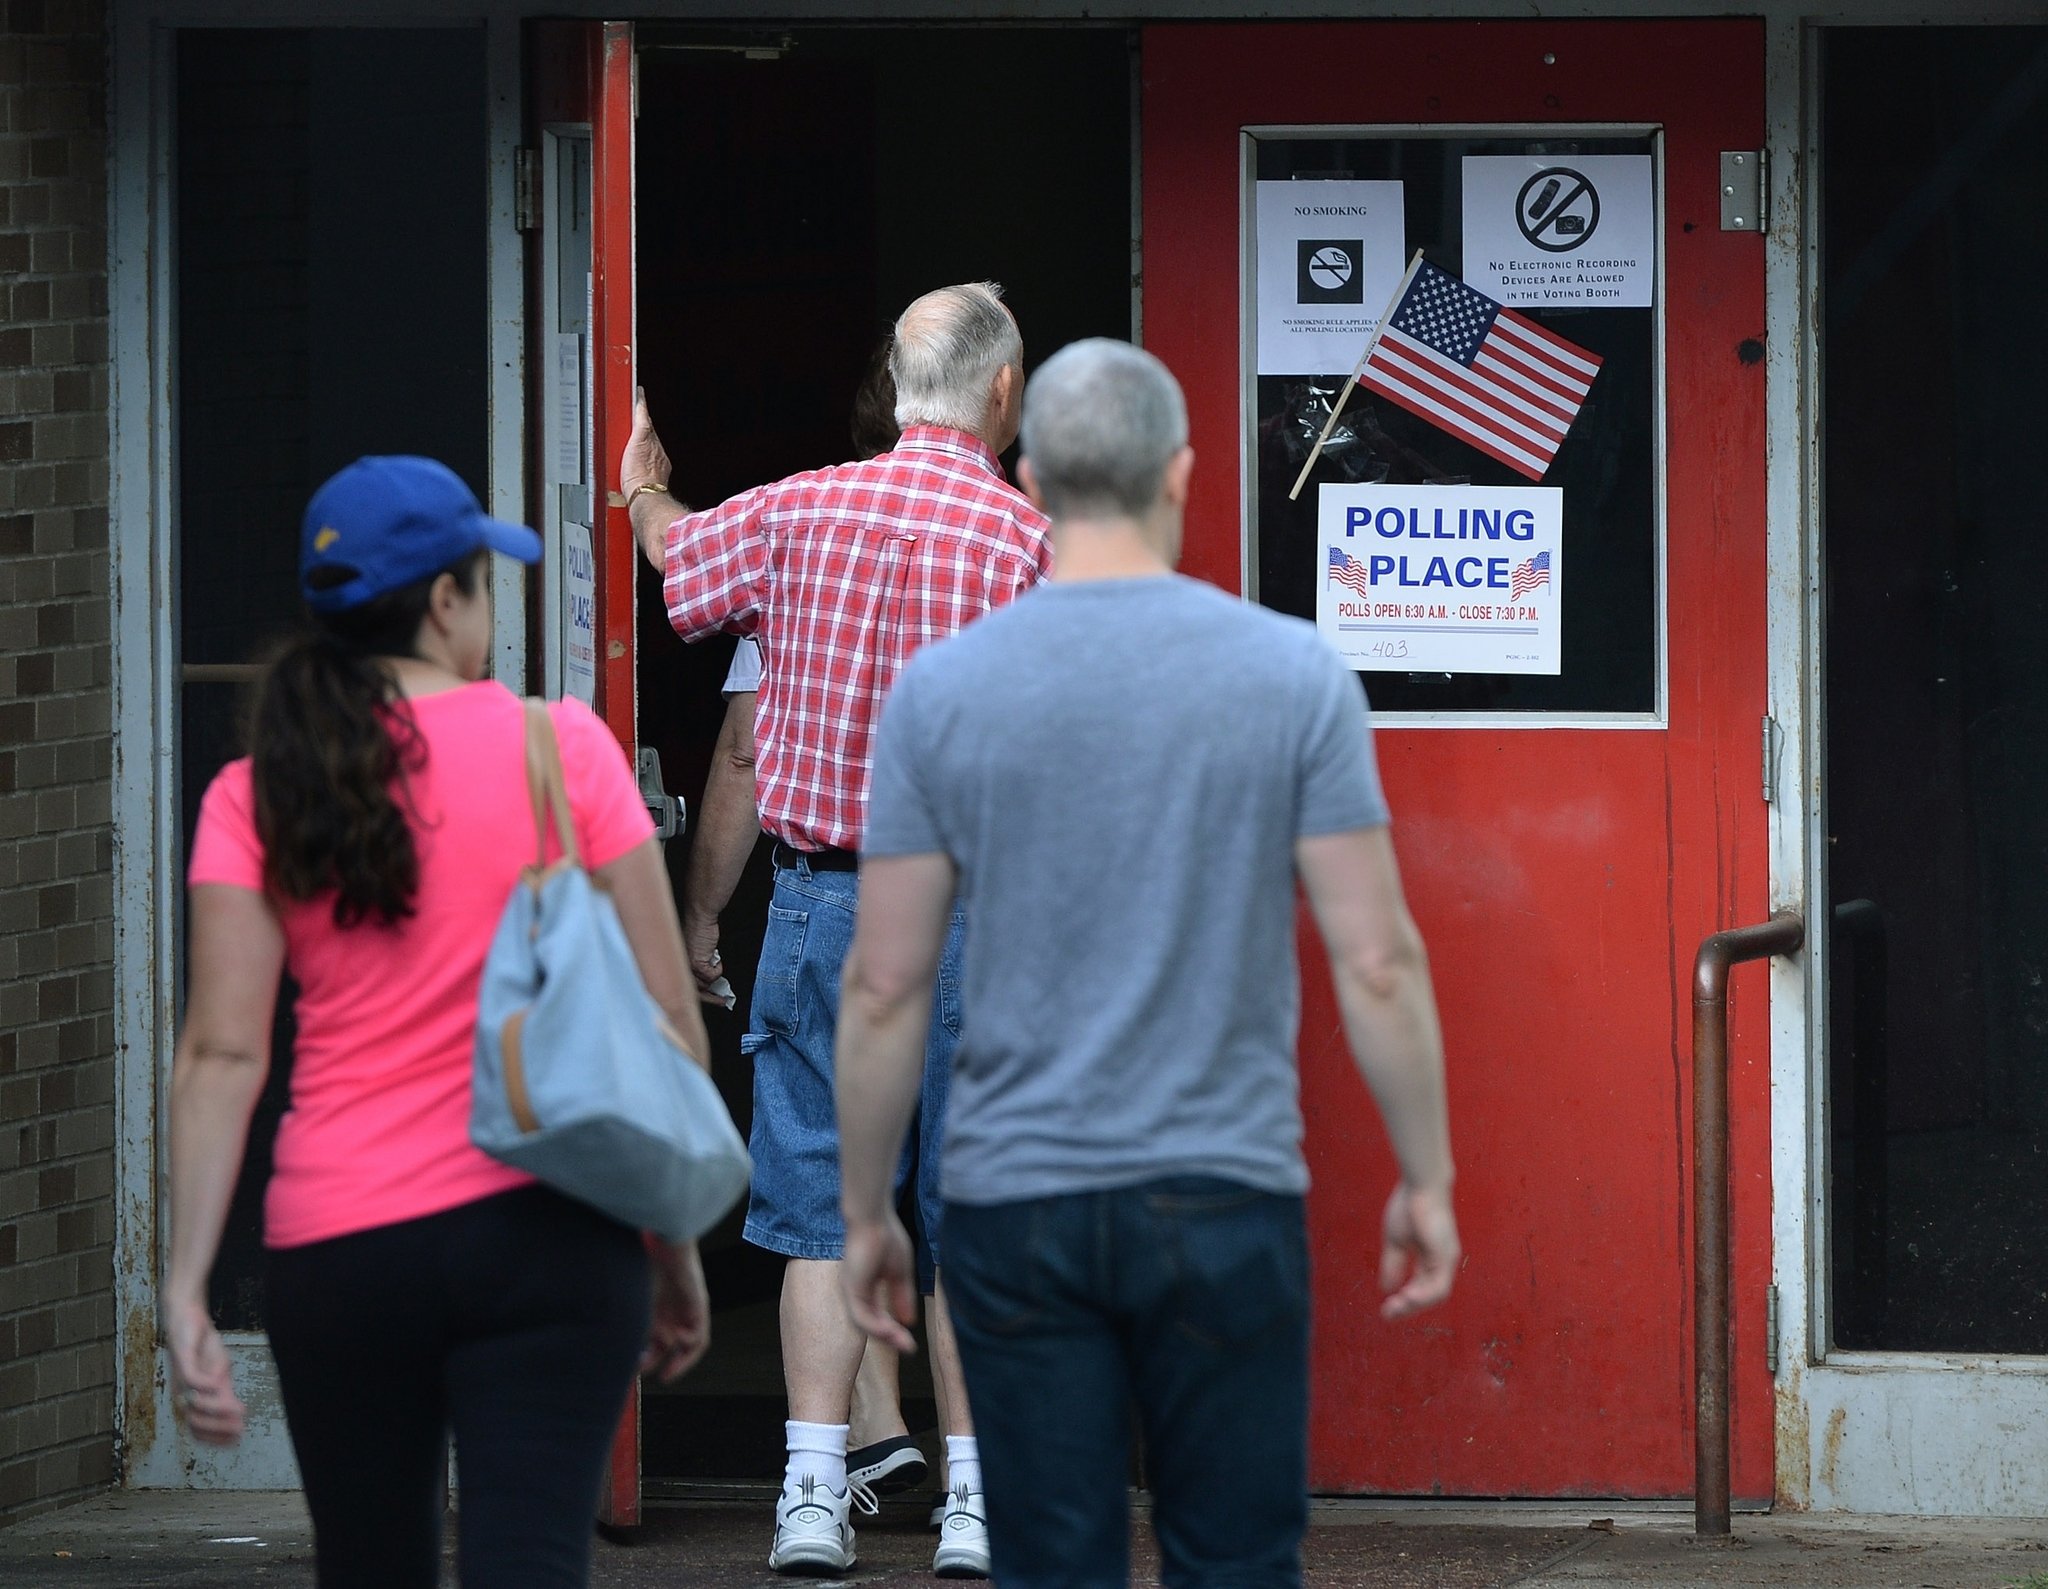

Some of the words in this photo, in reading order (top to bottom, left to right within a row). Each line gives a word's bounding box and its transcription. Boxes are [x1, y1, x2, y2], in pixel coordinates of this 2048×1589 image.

[1294, 206, 1311, 216] NO
[1313, 206, 1367, 216] SMOKING
[1346, 506, 1535, 541] POLLING
[1369, 555, 1510, 588] PLACE
[1338, 603, 1371, 617] POLLS
[1374, 603, 1402, 618] OPEN
[1405, 604, 1425, 618] 6:30
[1428, 605, 1448, 619] A.M.
[1459, 605, 1492, 620] CLOSE
[1495, 606, 1516, 620] 7:30
[1519, 607, 1539, 621] P.M.
[1372, 640, 1408, 658] 403
